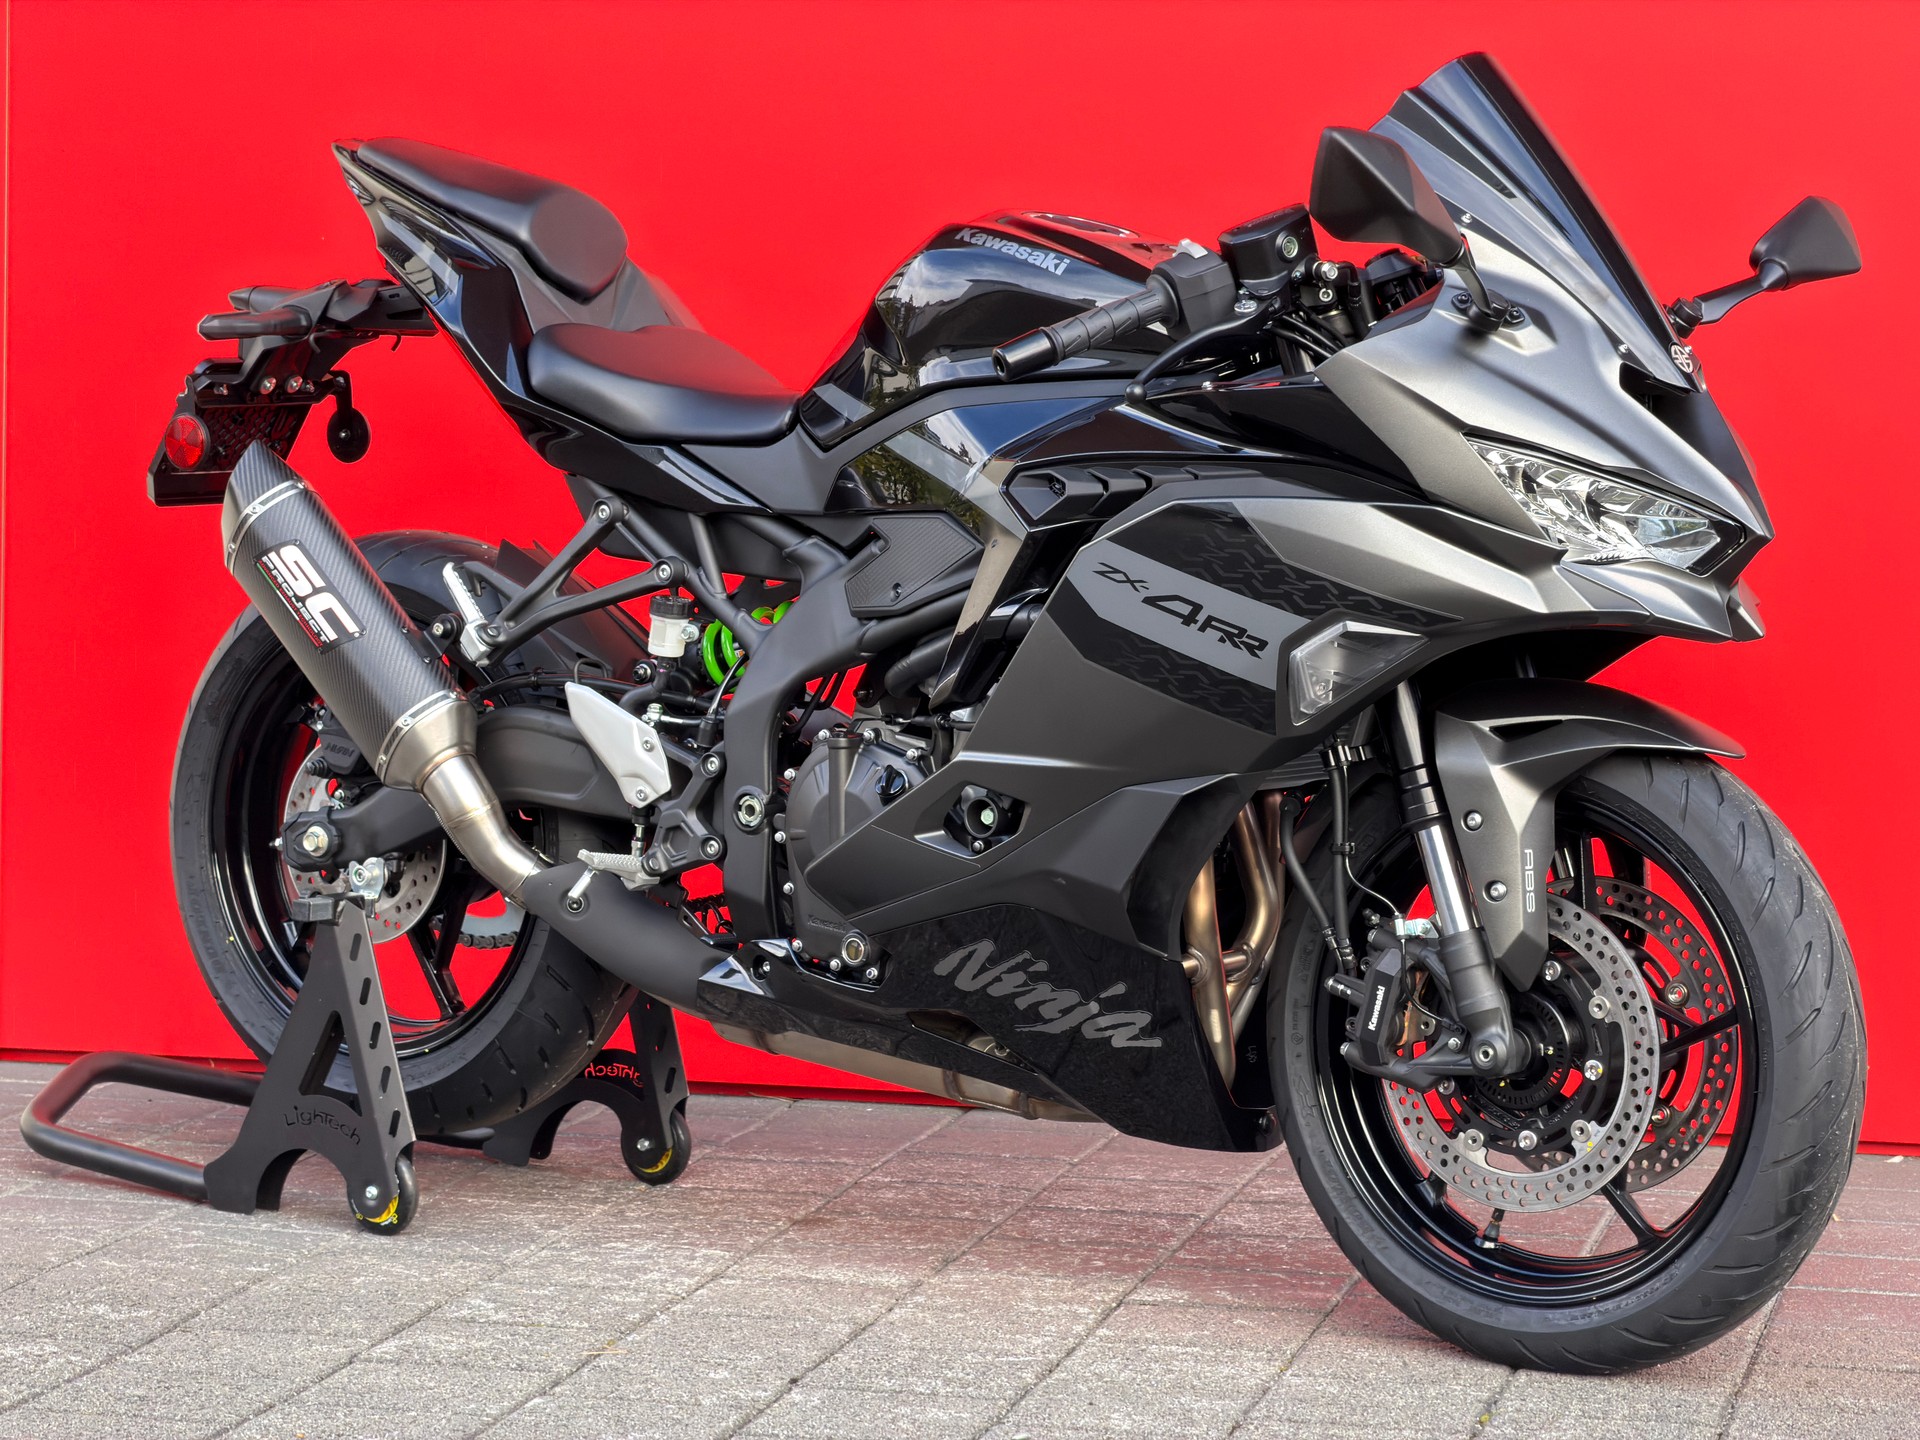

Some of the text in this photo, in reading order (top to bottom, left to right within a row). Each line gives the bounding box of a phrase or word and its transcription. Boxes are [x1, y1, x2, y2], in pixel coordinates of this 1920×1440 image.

[954, 227, 1071, 276] Kawasaki
[261, 555, 330, 643] PROJECT
[267, 544, 361, 642] SC
[1524, 849, 1536, 913] ABS
[933, 938, 1163, 1048] Ninja
[1367, 984, 1386, 1031] Kawasaki
